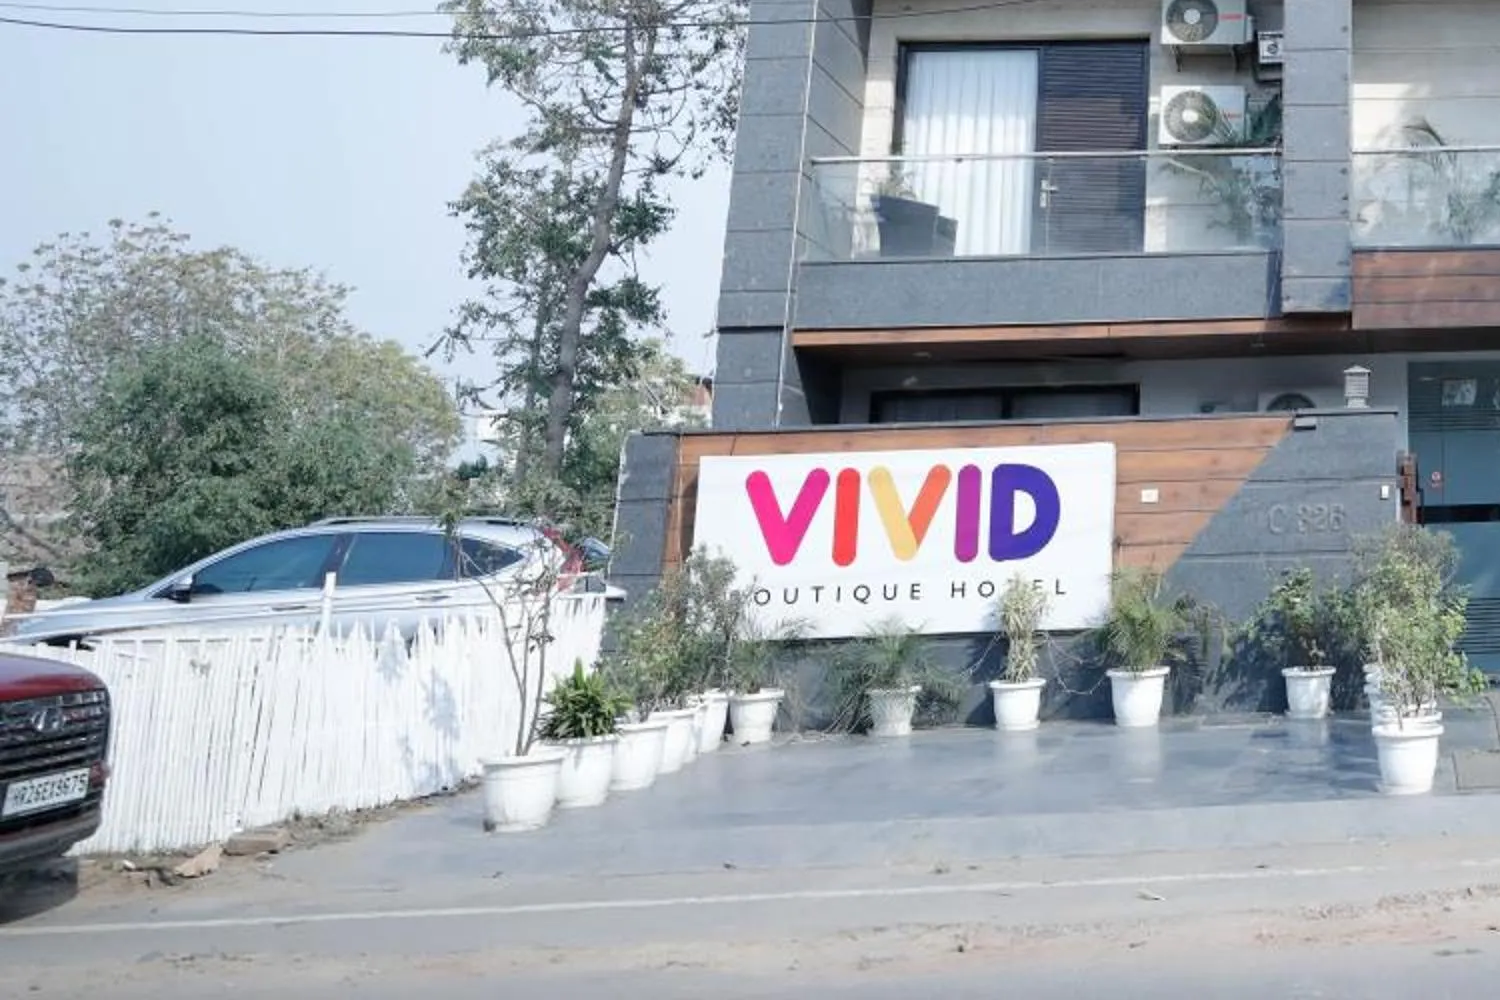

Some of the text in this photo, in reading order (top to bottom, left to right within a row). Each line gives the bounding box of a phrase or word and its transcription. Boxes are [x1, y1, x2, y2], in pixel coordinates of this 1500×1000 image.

[746, 464, 1061, 566] VIVID
[1268, 503, 1286, 534] C
[728, 578, 1066, 605] OUTIQUE HOEL
